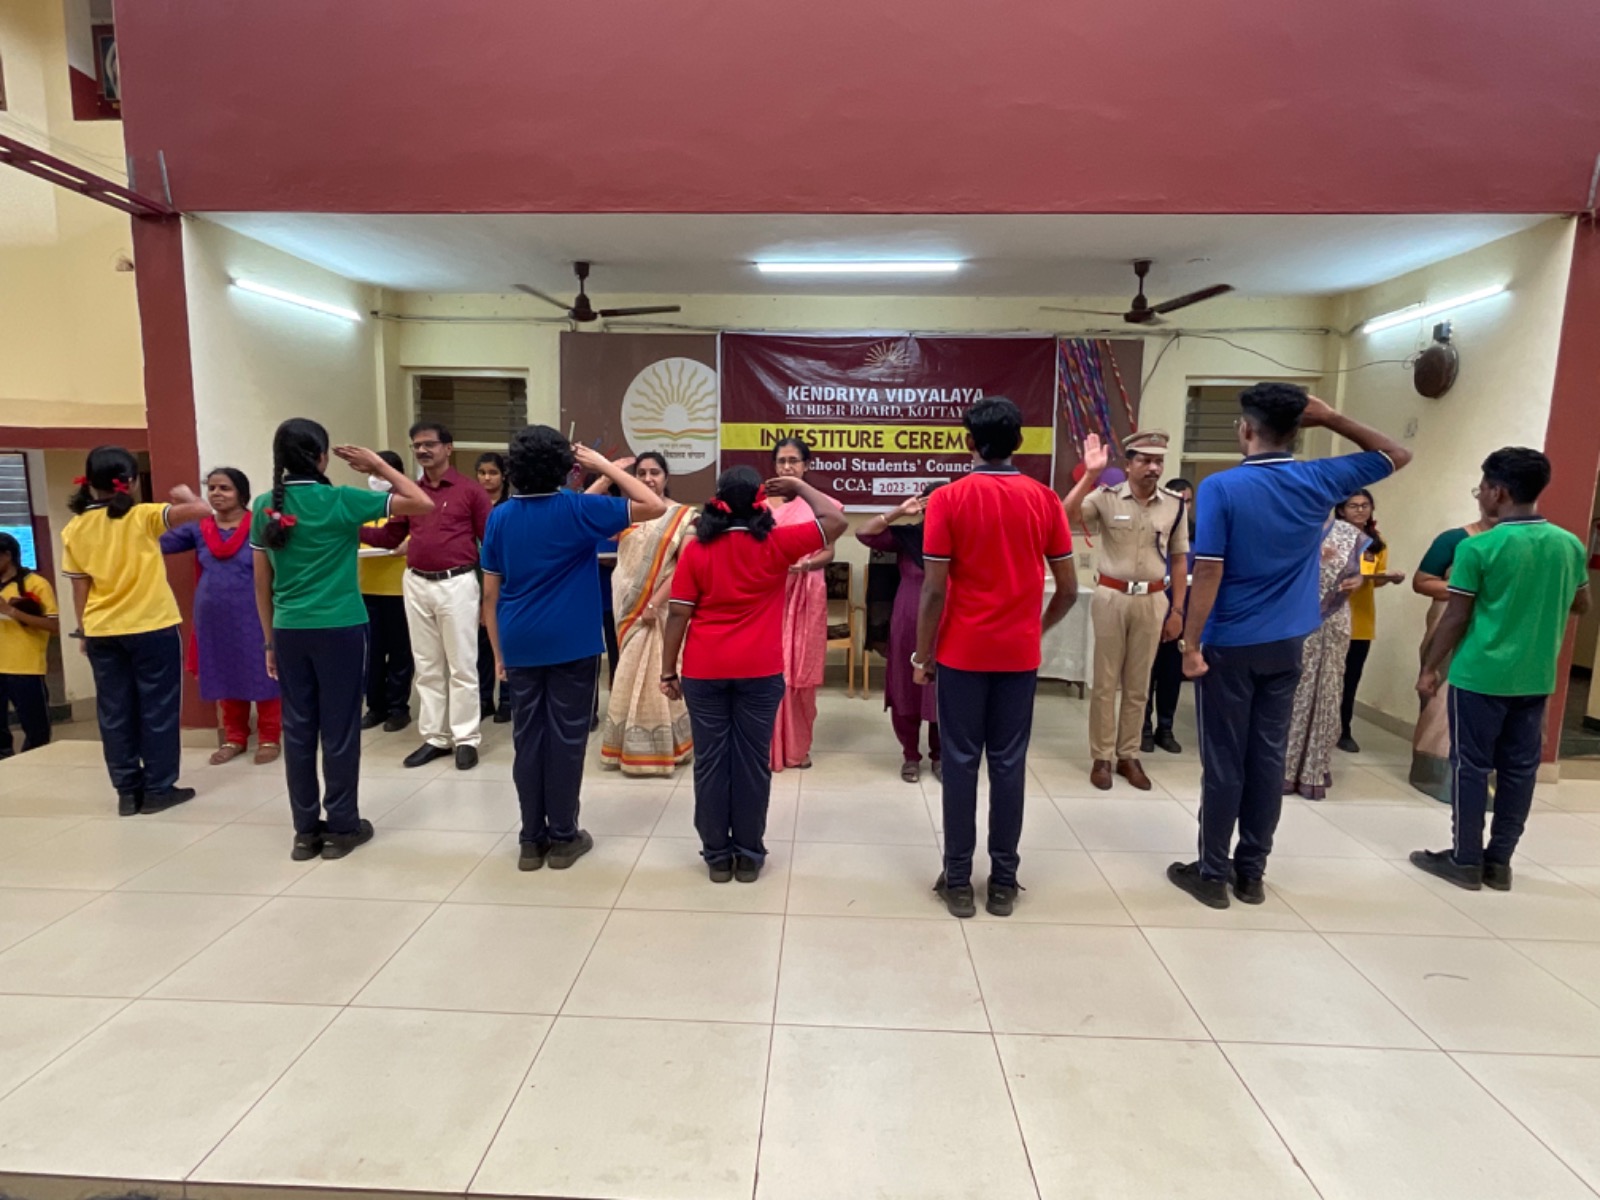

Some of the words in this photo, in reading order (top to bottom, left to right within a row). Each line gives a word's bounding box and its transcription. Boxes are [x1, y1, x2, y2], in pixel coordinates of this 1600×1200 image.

[788, 386, 879, 402] KENDRIYA
[885, 388, 983, 403] VIDYALAYA
[786, 404, 846, 416] RUBBER
[850, 405, 904, 418] BOARD,
[908, 405, 970, 418] KOTTAY
[894, 430, 974, 450] CEREM
[809, 458, 846, 471] chool
[926, 460, 974, 473] Counci
[832, 477, 873, 492] CCA:
[879, 482, 928, 494] 2023-20
